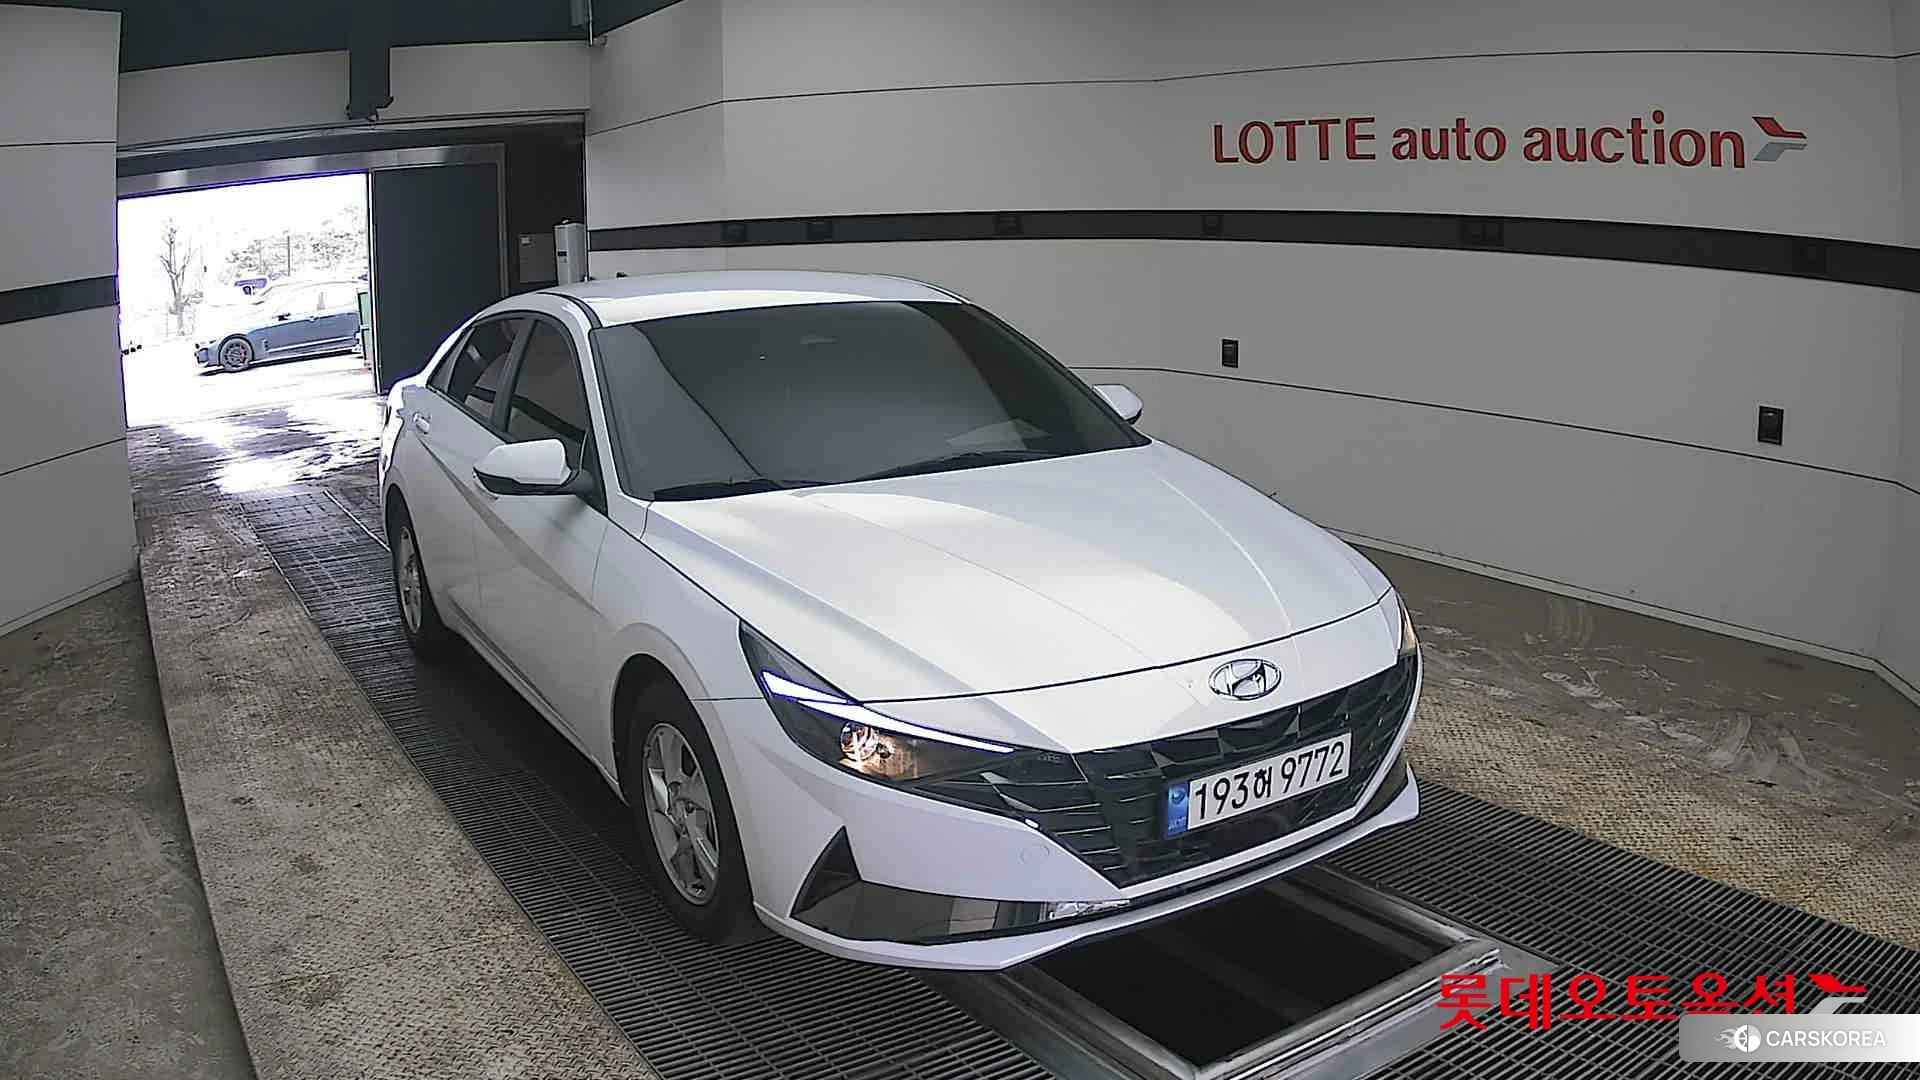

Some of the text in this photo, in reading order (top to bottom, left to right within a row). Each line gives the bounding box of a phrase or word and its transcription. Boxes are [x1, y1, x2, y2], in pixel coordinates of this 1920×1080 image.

[1213, 111, 1746, 169] LOTTE auto auction
[1195, 741, 1345, 820] 193허 9772
